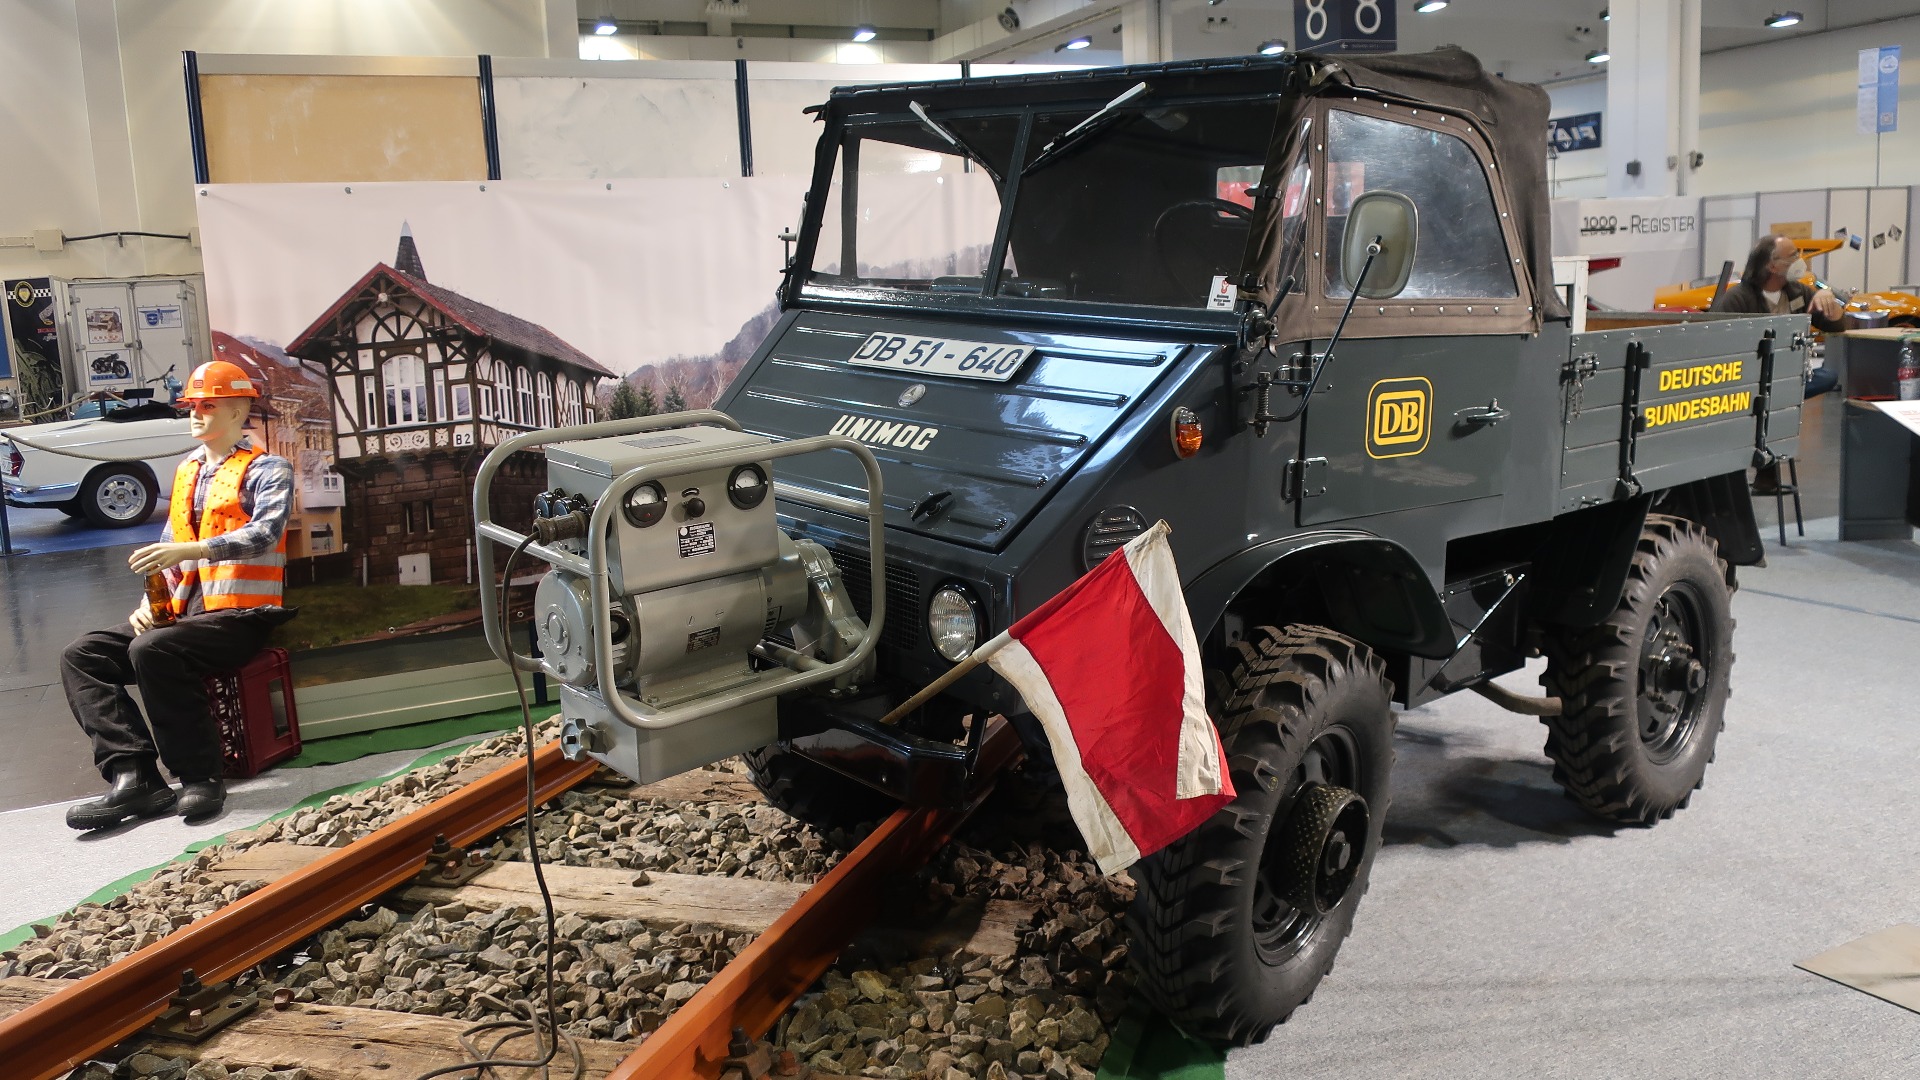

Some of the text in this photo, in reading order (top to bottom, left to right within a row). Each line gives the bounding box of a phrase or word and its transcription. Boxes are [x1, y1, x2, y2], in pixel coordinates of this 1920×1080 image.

[854, 335, 906, 362] DB
[902, 340, 945, 367] 51
[958, 346, 1024, 375] 640
[1658, 360, 1743, 392] DEUTSCHE
[1380, 401, 1419, 435] DB
[1644, 391, 1751, 428] BUNDESBAHN
